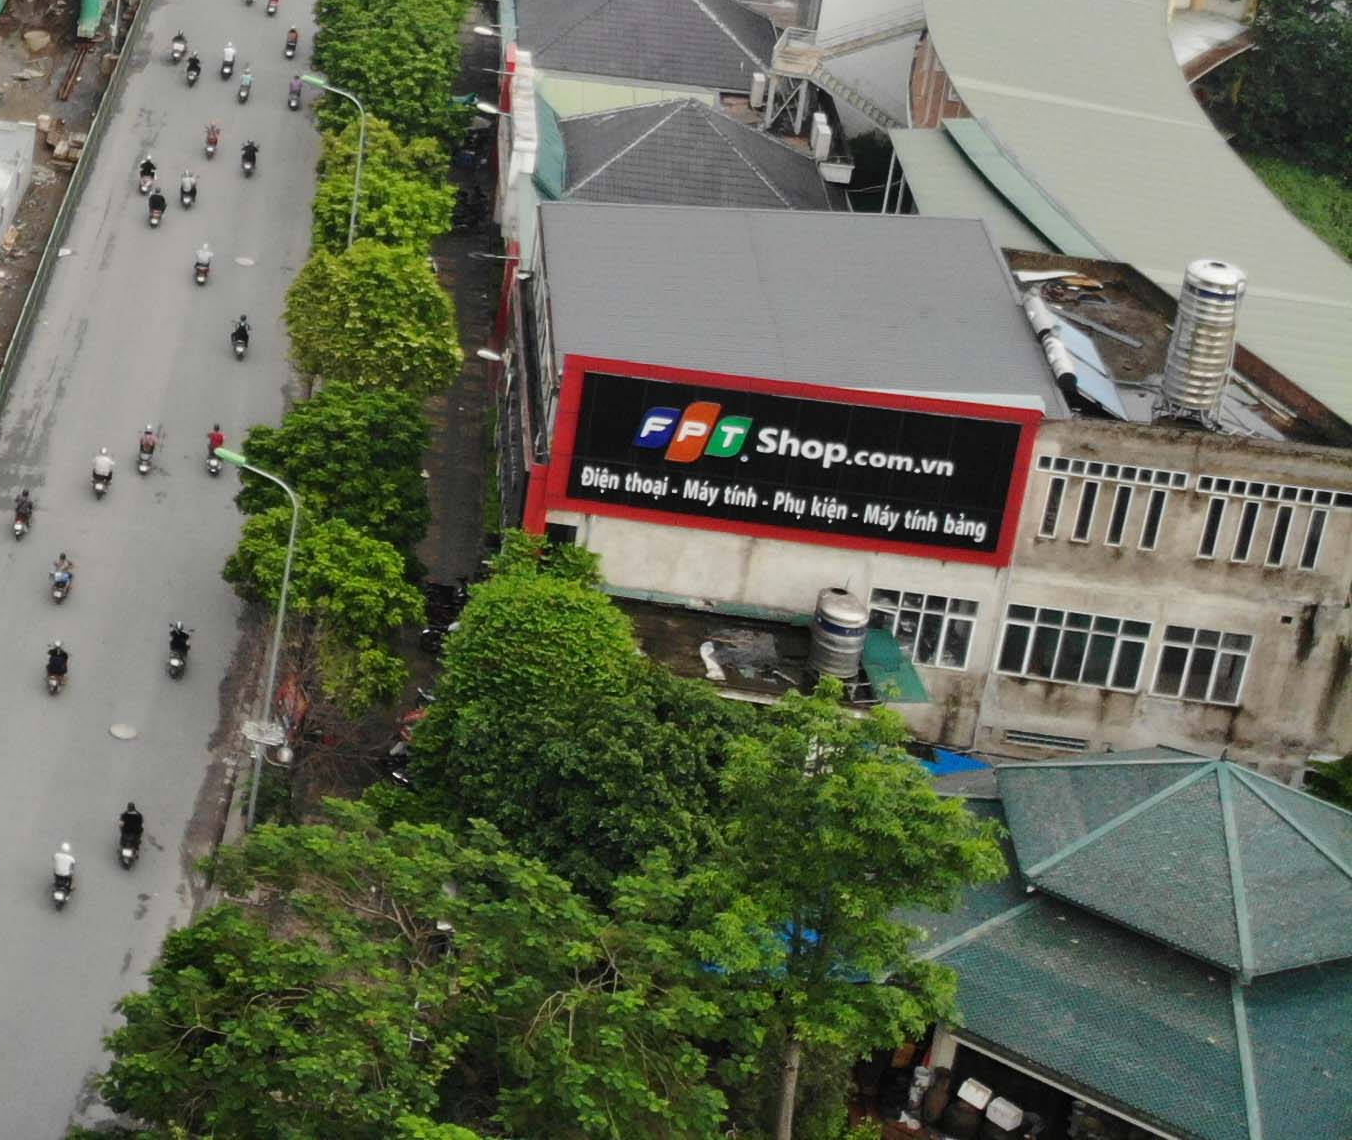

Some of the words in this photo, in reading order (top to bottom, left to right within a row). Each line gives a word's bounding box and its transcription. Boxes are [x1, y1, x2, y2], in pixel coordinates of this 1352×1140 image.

[637, 412, 749, 452] FPT
[756, 426, 955, 478] Shop.com.vn
[580, 466, 620, 491] Điện
[624, 470, 668, 499] thoại
[682, 477, 720, 508] Máy
[723, 482, 758, 509] tính
[772, 490, 807, 521] Phụ
[810, 492, 848, 524] kiện
[863, 502, 902, 532] Máy
[904, 507, 938, 534] tính
[943, 508, 988, 543] bảng
